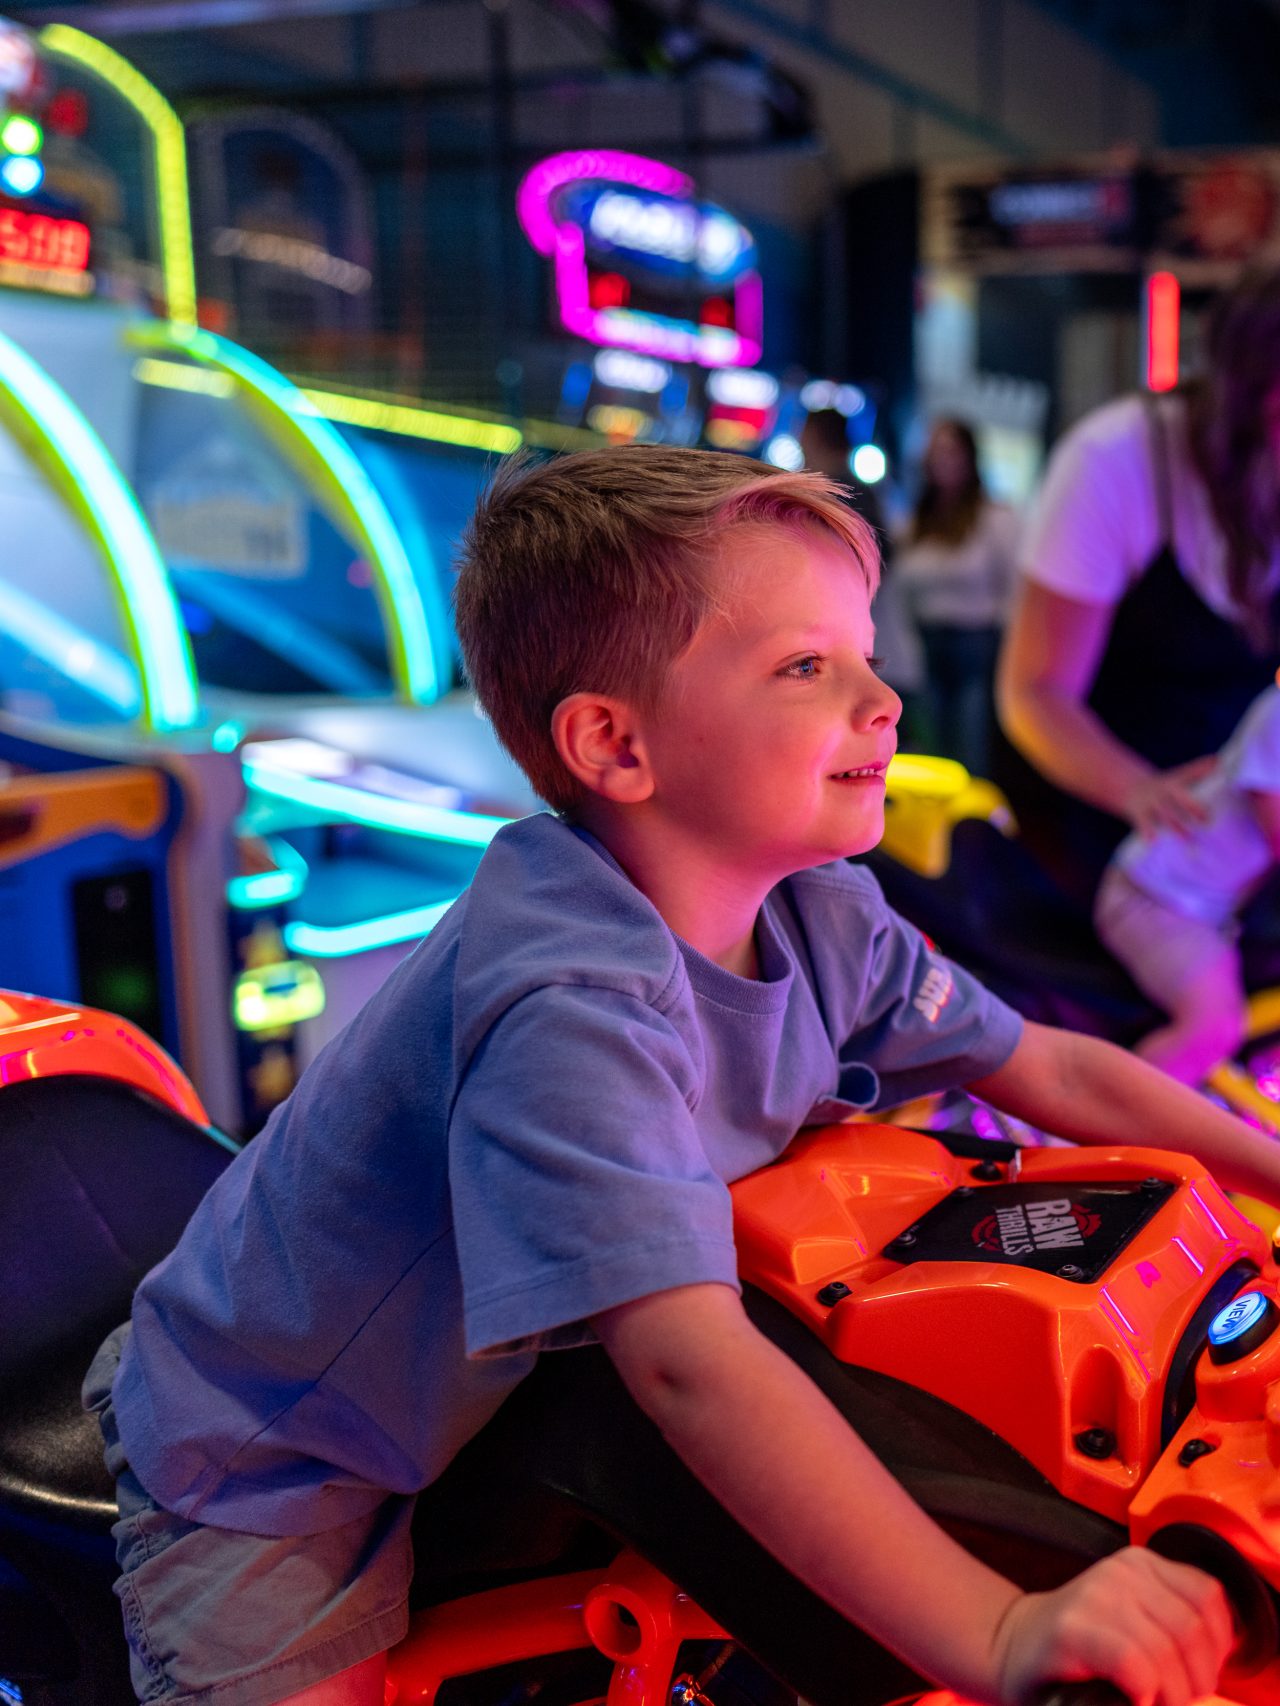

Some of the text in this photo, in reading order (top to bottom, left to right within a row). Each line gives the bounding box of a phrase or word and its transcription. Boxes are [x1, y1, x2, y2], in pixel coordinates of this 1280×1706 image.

[995, 1204, 1035, 1256] THRILLS
[1025, 1198, 1085, 1250] RAW
[1221, 1299, 1251, 1329] VIEW
